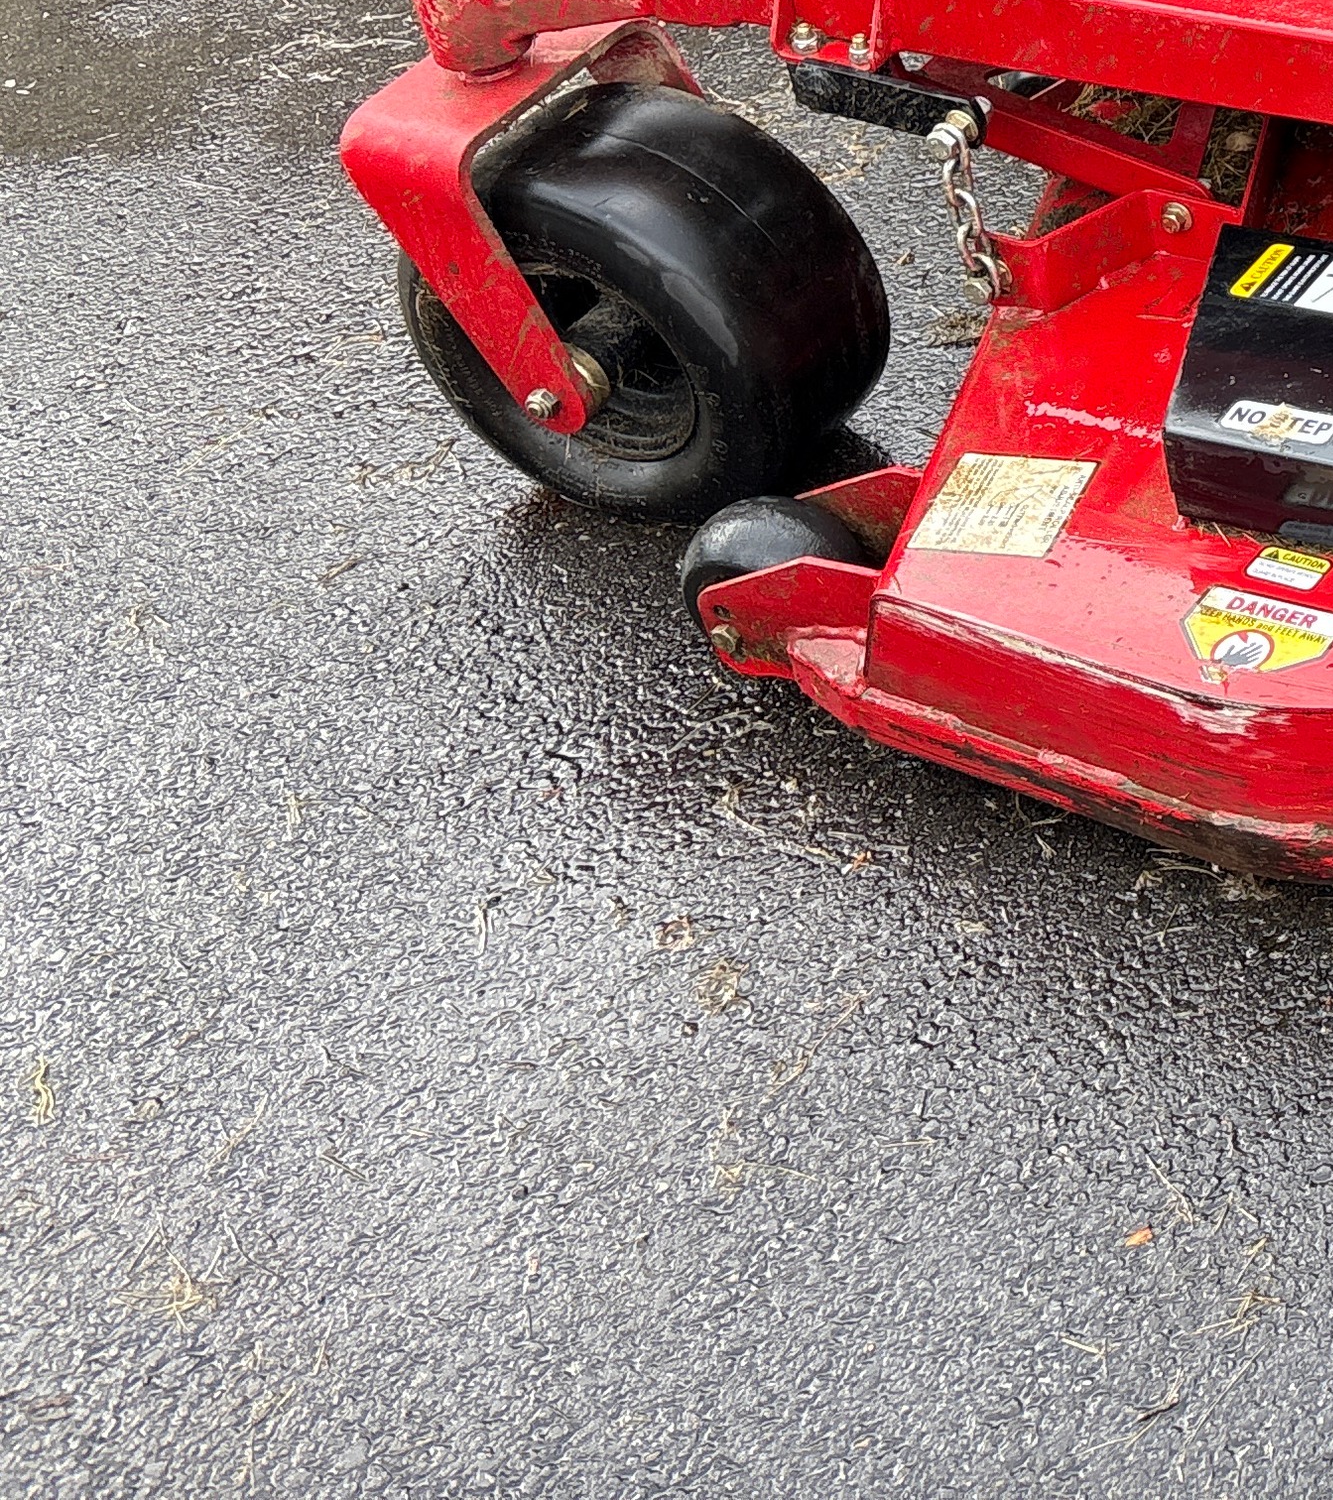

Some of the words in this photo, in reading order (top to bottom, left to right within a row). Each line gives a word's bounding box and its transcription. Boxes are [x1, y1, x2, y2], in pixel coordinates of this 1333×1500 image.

[1250, 248, 1285, 280] CAUTION
[1228, 406, 1267, 425] NO
[1281, 553, 1327, 570] CAUTION
[1225, 595, 1318, 630] DANGER
[1256, 621, 1275, 632] and
[1275, 626, 1299, 638] FEET
[1299, 631, 1328, 645] AWAY
